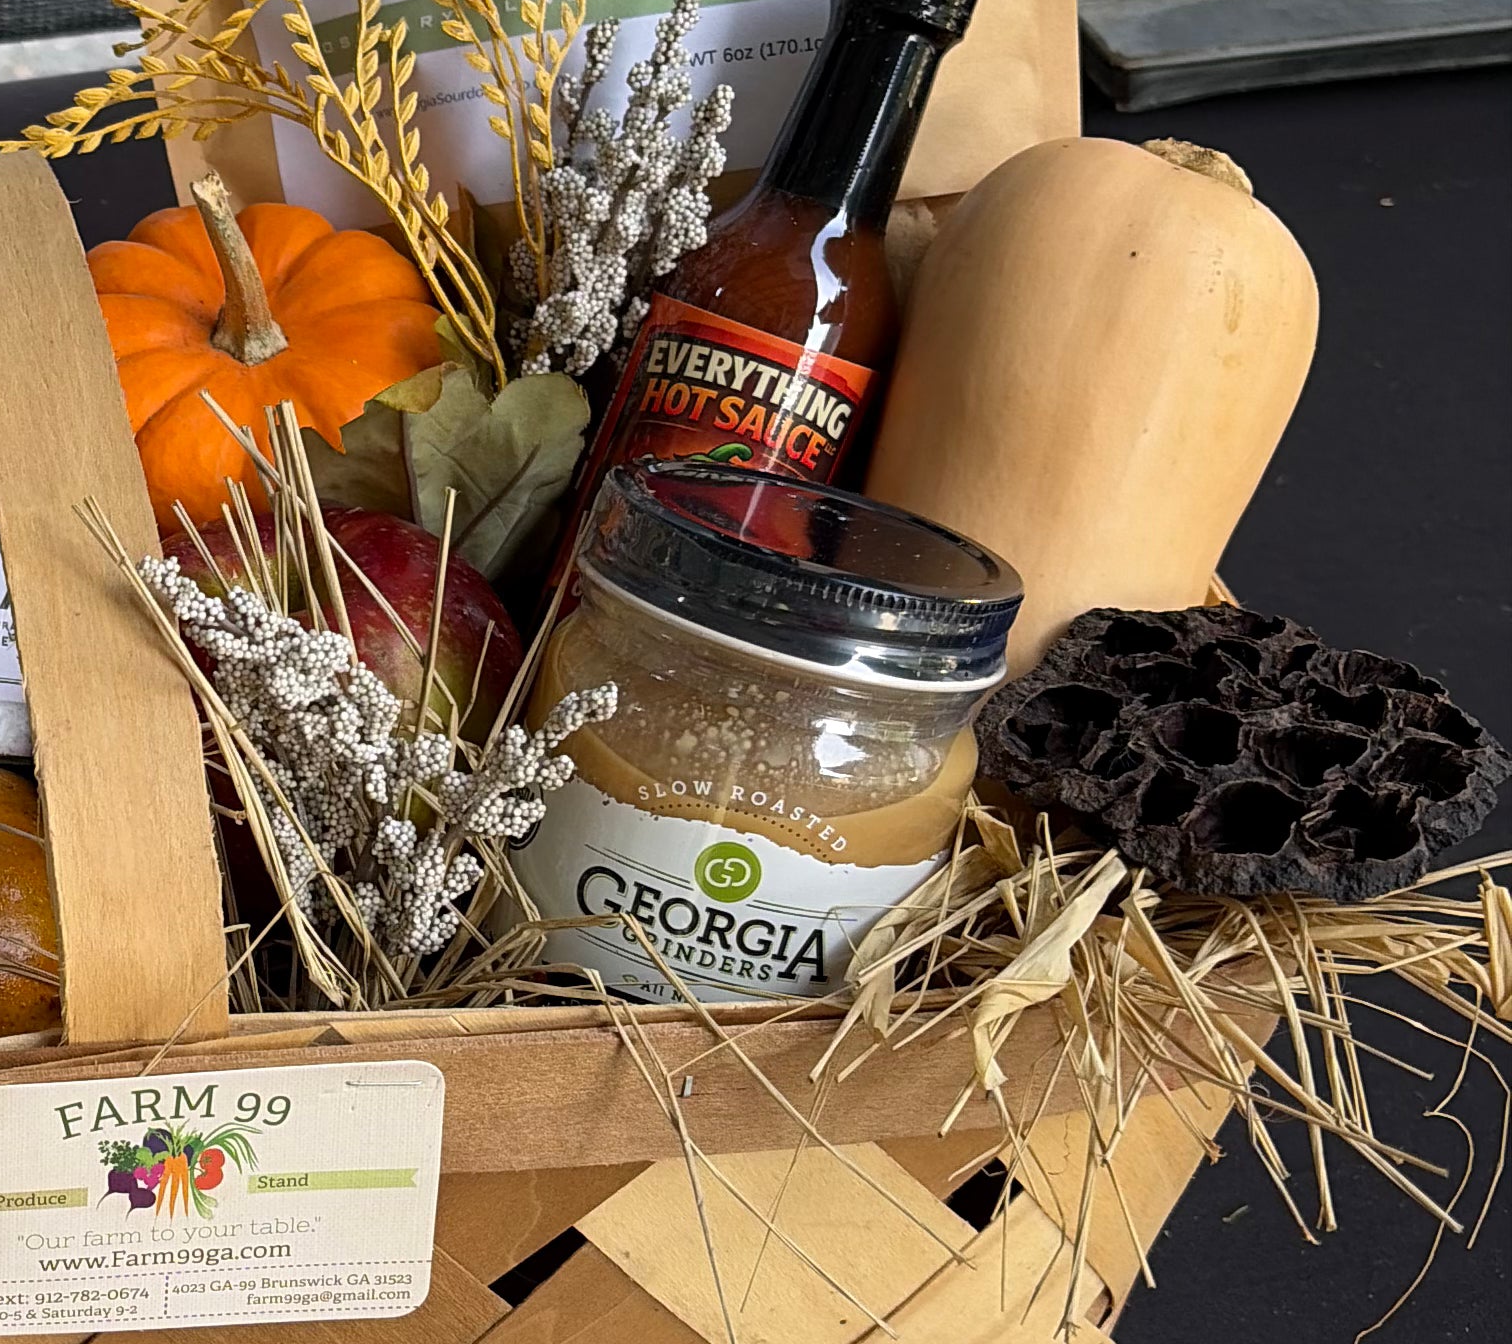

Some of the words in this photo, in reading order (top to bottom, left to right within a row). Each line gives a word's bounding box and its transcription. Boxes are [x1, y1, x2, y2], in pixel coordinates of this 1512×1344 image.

[723, 47, 754, 64] 6oz
[647, 340, 852, 440] EVERYTHING
[640, 378, 717, 422] HOT
[712, 395, 827, 471] SAUCE
[638, 780, 712, 801] SLOW
[730, 785, 847, 852] ROASTED
[576, 865, 829, 983] GEORGIA
[640, 979, 664, 997] All
[54, 1084, 219, 1140] FARM
[233, 1092, 292, 1127] 99
[257, 1173, 309, 1189] Stand
[18, 1233, 75, 1250] "Our
[82, 1229, 142, 1247] farm
[151, 1227, 175, 1243] to
[182, 1223, 243, 1244] your
[249, 1216, 321, 1236] table."
[38, 1243, 292, 1272] www.Farm99ga.com
[172, 1283, 206, 1295] 4023
[210, 1279, 256, 1292] GA-99
[261, 1274, 342, 1289] Brunswick
[347, 1274, 370, 1286] GA
[374, 1274, 413, 1286] 31523
[35, 1287, 150, 1306] 912-782-0674
[247, 1289, 411, 1306] farm99ga@gmail.com
[26, 1309, 38, 1320] &
[42, 1305, 112, 1319] Saturday
[115, 1305, 138, 1318] 9-2
